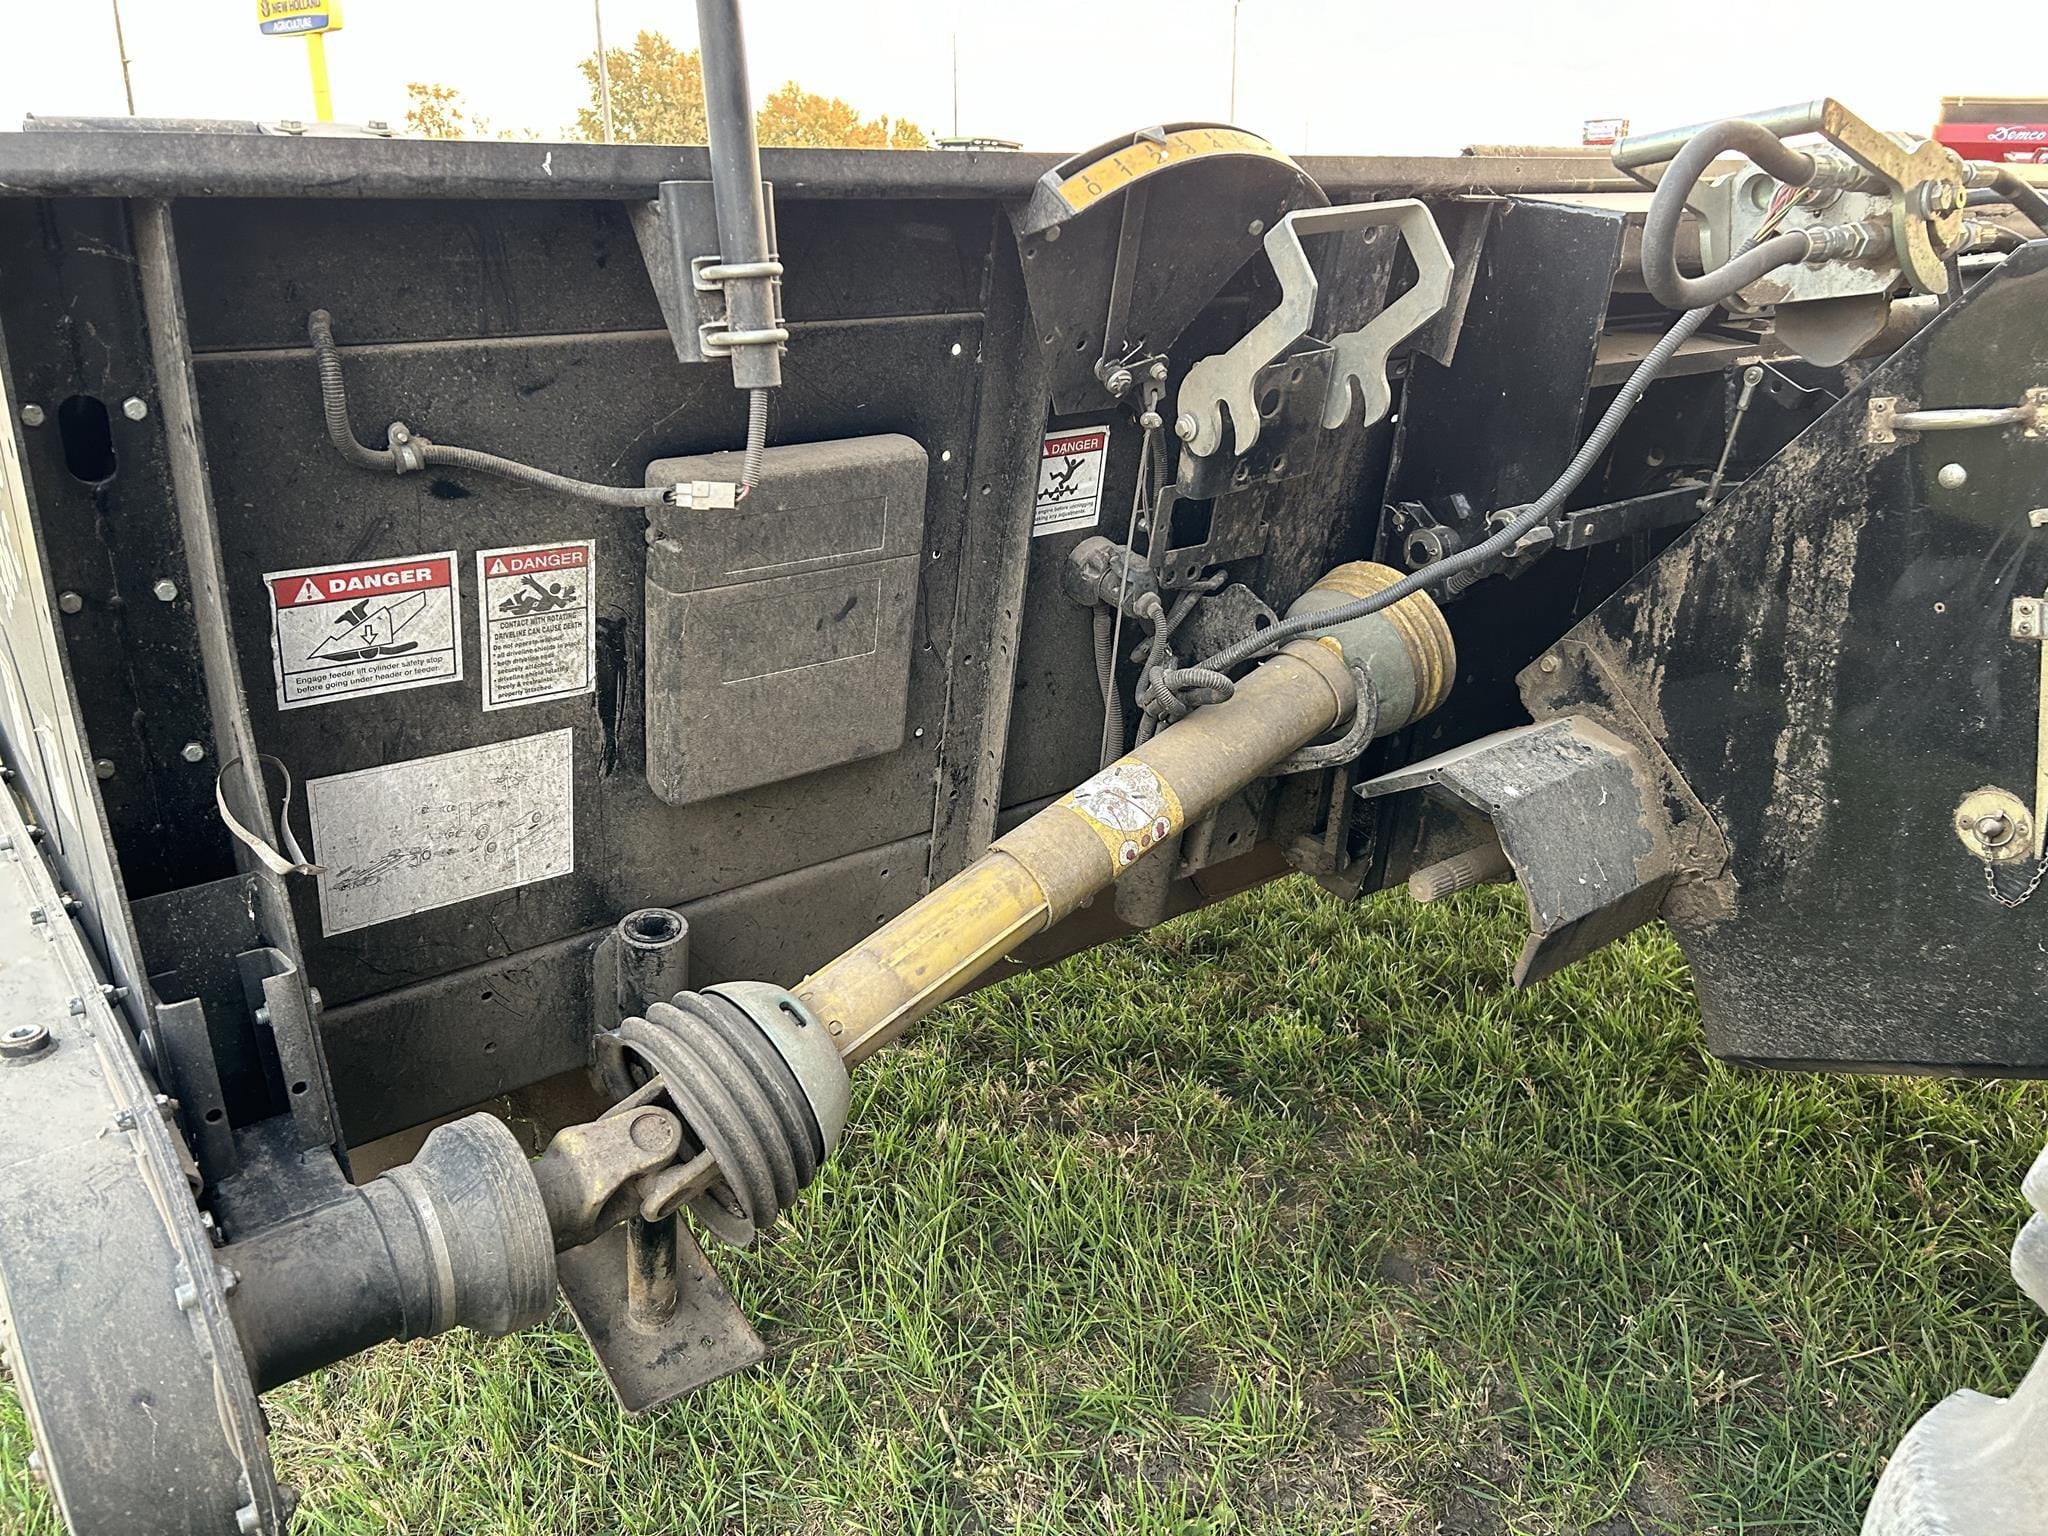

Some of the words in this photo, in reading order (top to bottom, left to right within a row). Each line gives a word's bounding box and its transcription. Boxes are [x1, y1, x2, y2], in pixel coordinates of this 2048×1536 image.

[272, 2, 288, 13] NEW
[273, 17, 312, 32] AGRICULTURE
[1987, 125, 2046, 142] Demco
[1087, 182, 1102, 196] 0
[1120, 165, 1134, 177] 1
[1150, 151, 1168, 165] 2
[1051, 438, 1099, 455] DANGER
[511, 552, 583, 571] DANGER
[328, 568, 433, 593] DANGER
[500, 618, 529, 629] CONTACT
[531, 616, 546, 625] WITH
[547, 612, 577, 622] ROTATING
[494, 629, 526, 640] DRIVELINE
[528, 627, 541, 636] CAN
[542, 624, 561, 633] CAUSE
[563, 621, 583, 631] DEATH
[506, 648, 534, 658] driveline
[535, 644, 556, 654] shields
[514, 639, 538, 650] operate
[295, 674, 327, 686] Engage
[329, 670, 354, 680] feeder
[357, 667, 366, 675] lift
[368, 662, 399, 674] cylinder
[402, 659, 424, 669] safety
[426, 656, 443, 665] stop
[497, 659, 512, 668] both
[497, 666, 523, 676] securely
[296, 684, 323, 694] before
[325, 680, 348, 691] going
[350, 675, 373, 685] under
[375, 670, 402, 680] header
[414, 665, 441, 674] feeder.
[497, 673, 524, 683] driveline
[525, 669, 544, 678] shield
[497, 682, 515, 692] freely
[497, 690, 523, 701] properly
